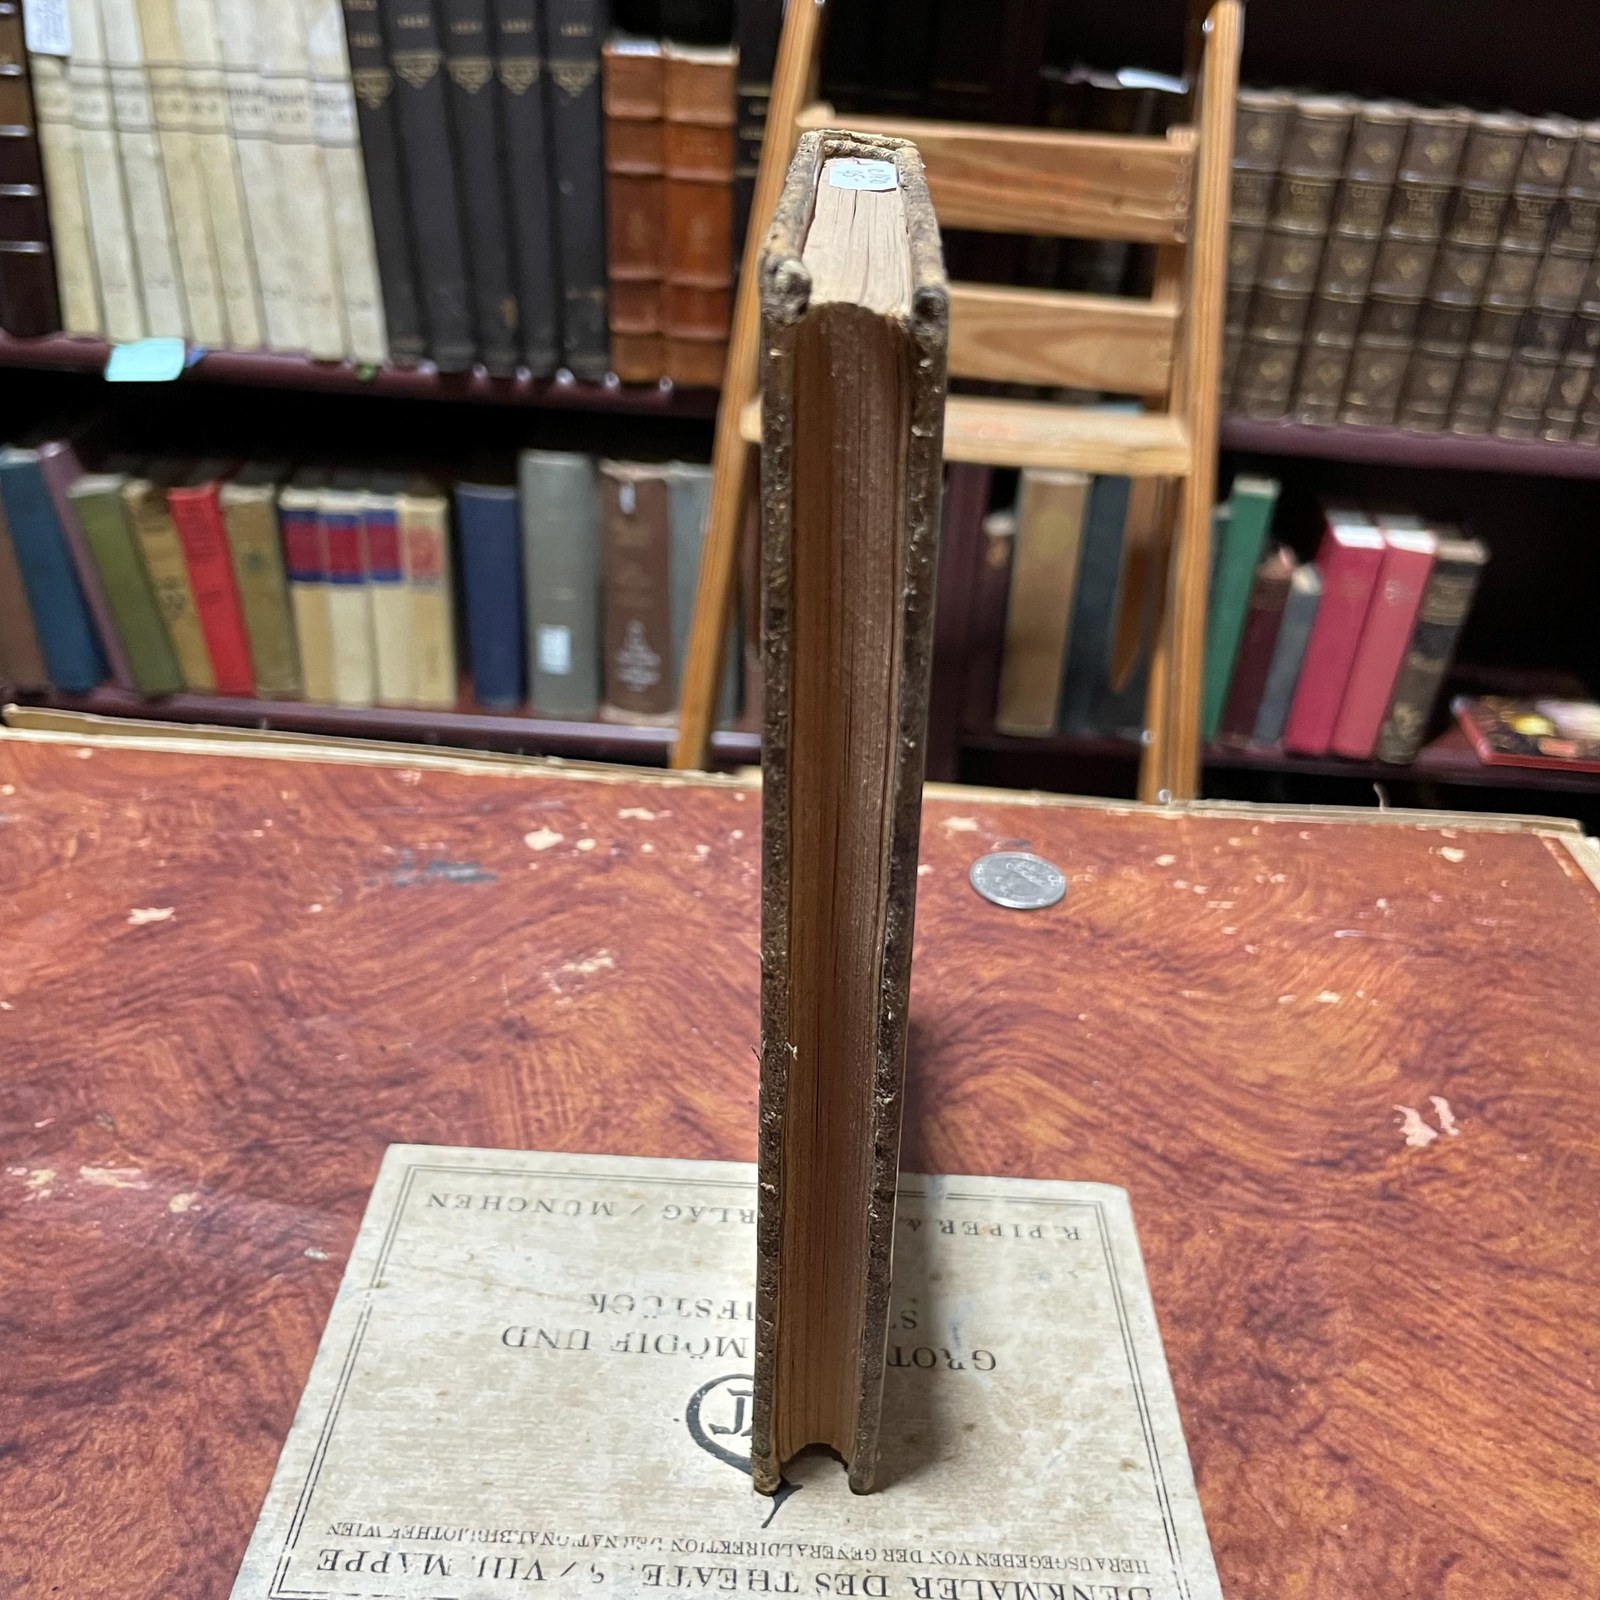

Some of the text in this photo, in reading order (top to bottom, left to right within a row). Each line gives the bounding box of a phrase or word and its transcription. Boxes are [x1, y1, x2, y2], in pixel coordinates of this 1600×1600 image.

[661, 1203, 755, 1224] RLAG
[935, 1219, 1042, 1239] PIPER
[502, 1325, 592, 1351] UND
[326, 1521, 382, 1538] WIEN
[671, 1537, 877, 1562] GENERALDIREKTION
[883, 1548, 923, 1563] DER
[929, 1550, 974, 1566] VON
[315, 1548, 453, 1577] MAPPE
[976, 1553, 1150, 1574] HERAUSGEGEBEN
[815, 1572, 891, 1598] DES
